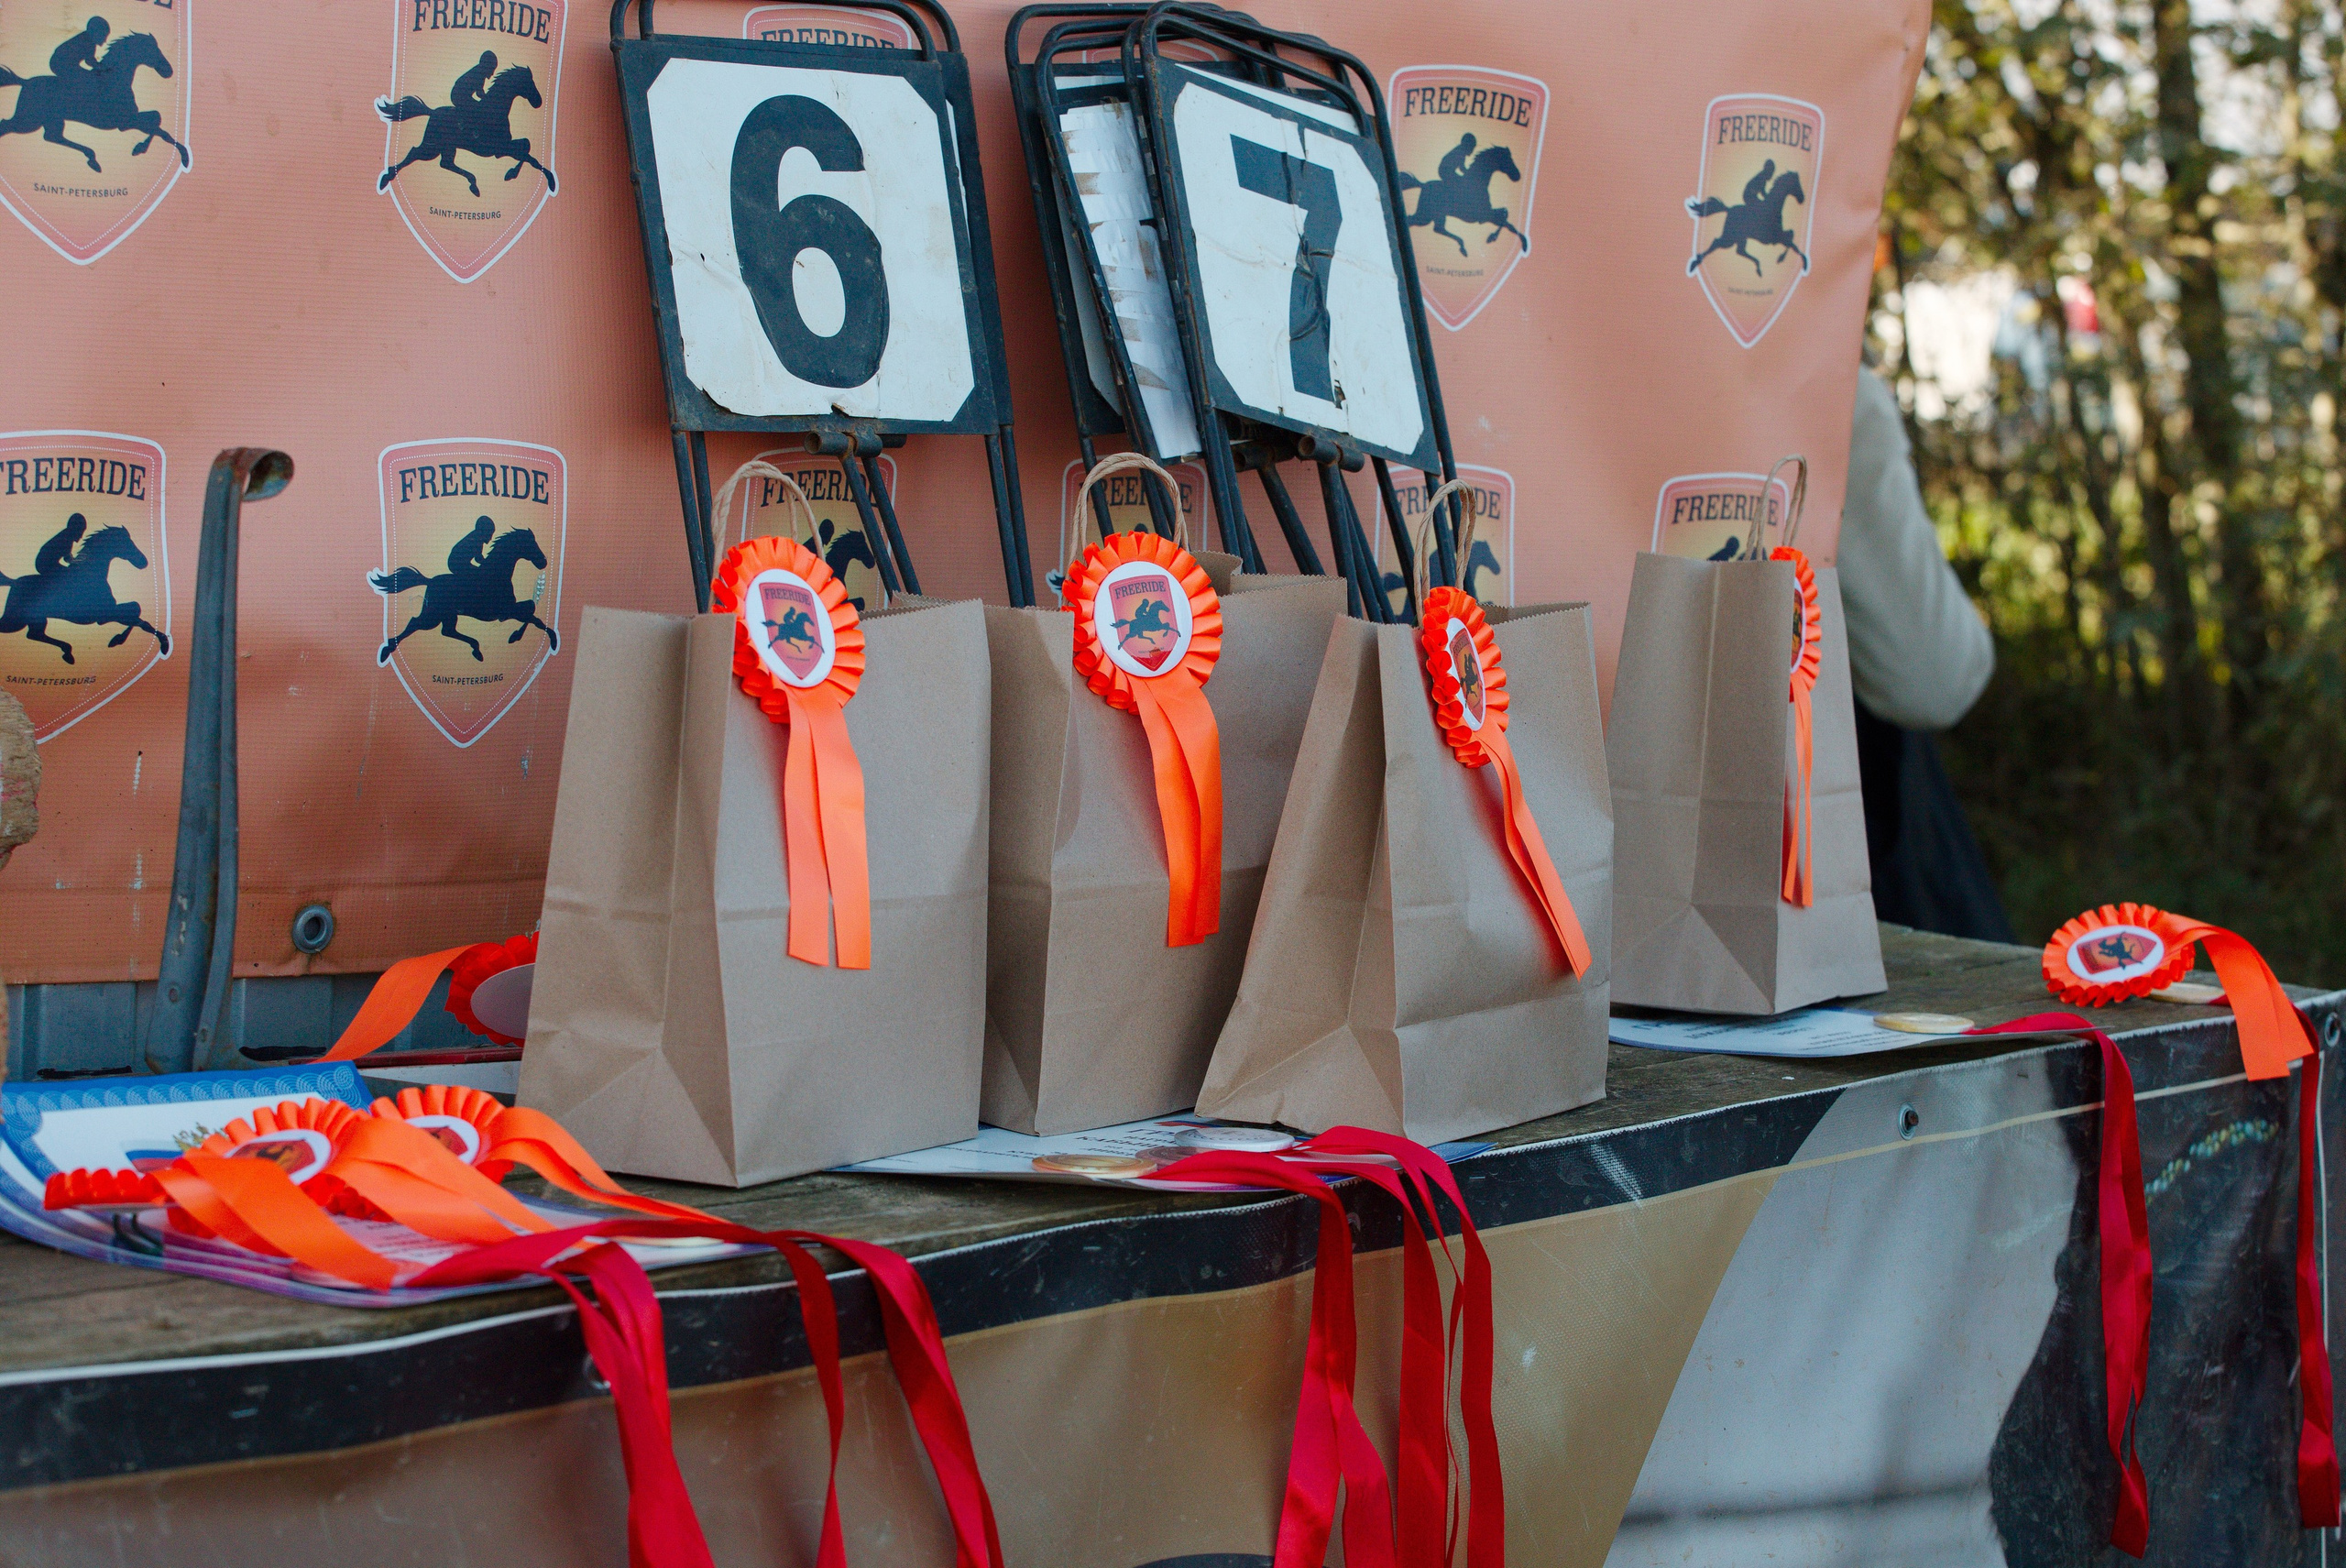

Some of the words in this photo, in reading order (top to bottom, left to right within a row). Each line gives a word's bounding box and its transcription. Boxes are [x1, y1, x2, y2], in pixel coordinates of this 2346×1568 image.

[413, 0, 551, 44] FREERIDE
[1405, 86, 1532, 128] FREERIDE
[1718, 115, 1814, 153] FREERIDE
[34, 182, 128, 198] SAINT-PETERSBURG
[429, 206, 501, 220] SAINT-PETERSBURG
[730, 94, 889, 388] 6
[1230, 134, 1343, 402] 7
[0, 457, 147, 501] REERIDE
[399, 463, 550, 505] FREERIDE
[1672, 493, 1779, 526] FREERIE
[764, 588, 812, 606] FREERIDE
[1114, 580, 1166, 600] FREERIDE
[6, 674, 96, 685] SAINT-PETERSBURG
[432, 674, 504, 685] SAINT-PETERSBURG
